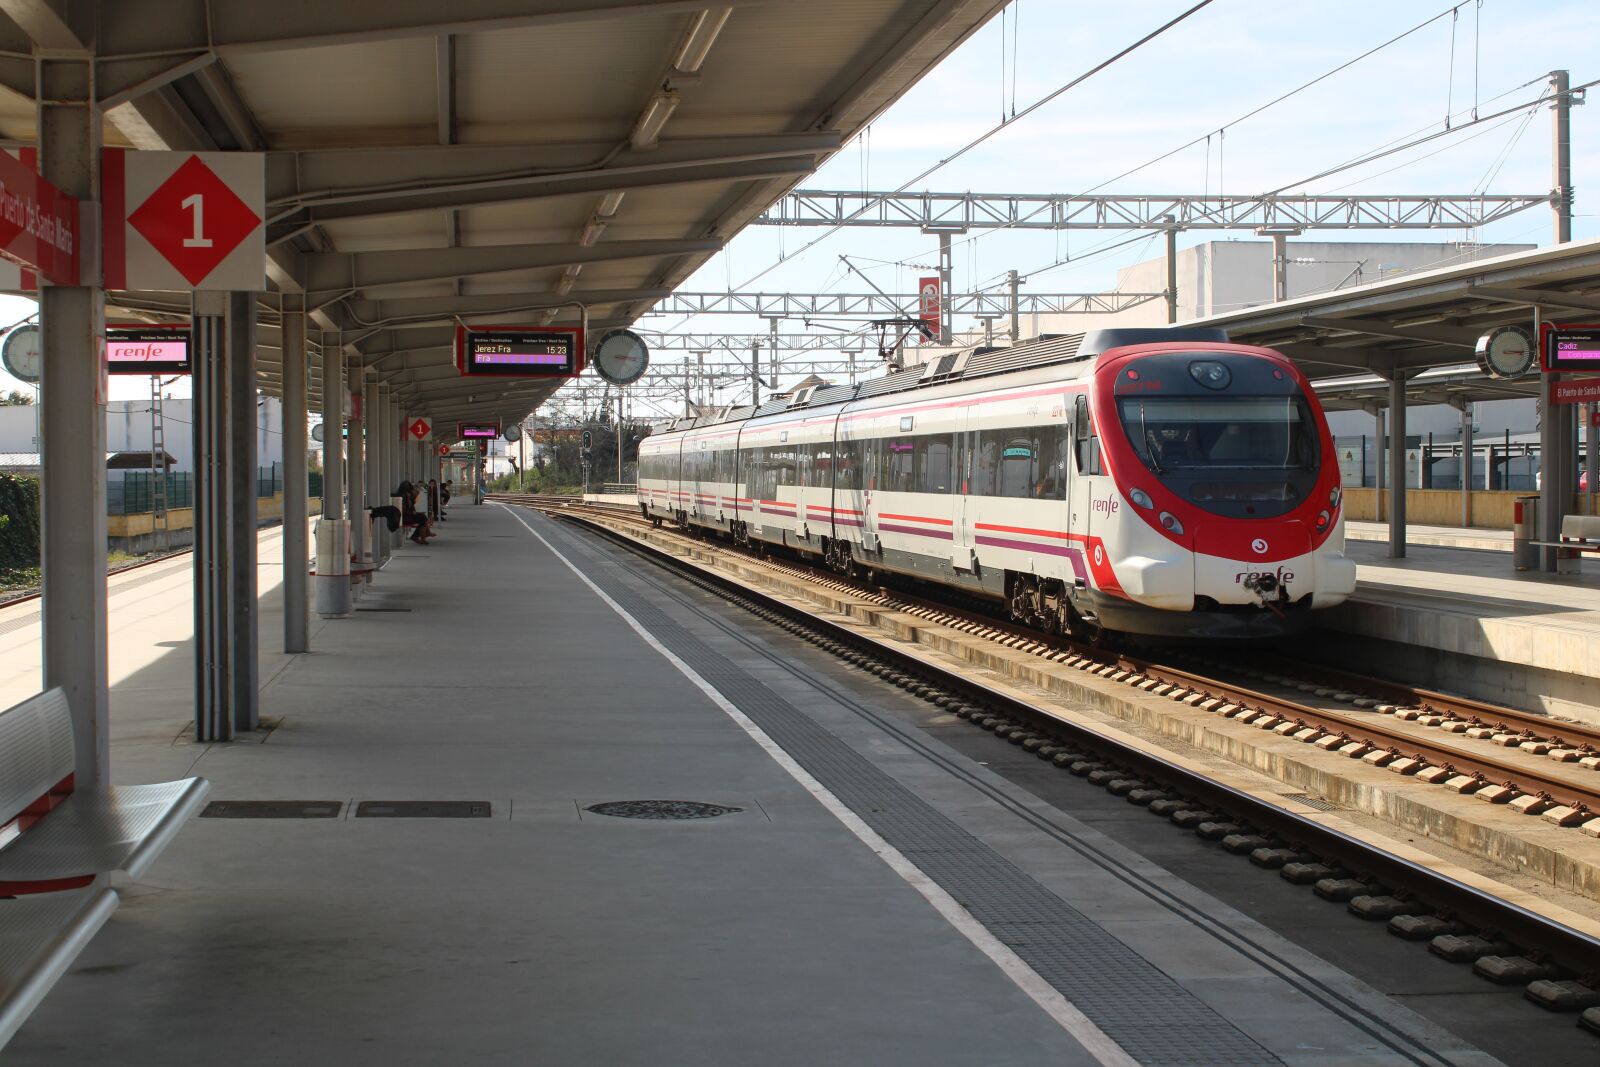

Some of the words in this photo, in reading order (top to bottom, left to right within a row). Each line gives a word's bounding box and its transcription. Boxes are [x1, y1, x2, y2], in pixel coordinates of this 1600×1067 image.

[25, 196, 35, 234] de
[36, 203, 54, 245] Santa
[181, 193, 214, 248] 1
[114, 343, 163, 361] renfe
[474, 344, 496, 353] Jerez
[498, 345, 511, 353] Fra
[546, 346, 567, 354] 15:23
[477, 354, 491, 362] Fra
[1584, 386, 1596, 396] Santa
[417, 425, 424, 434] 1
[1092, 494, 1119, 519] renfe
